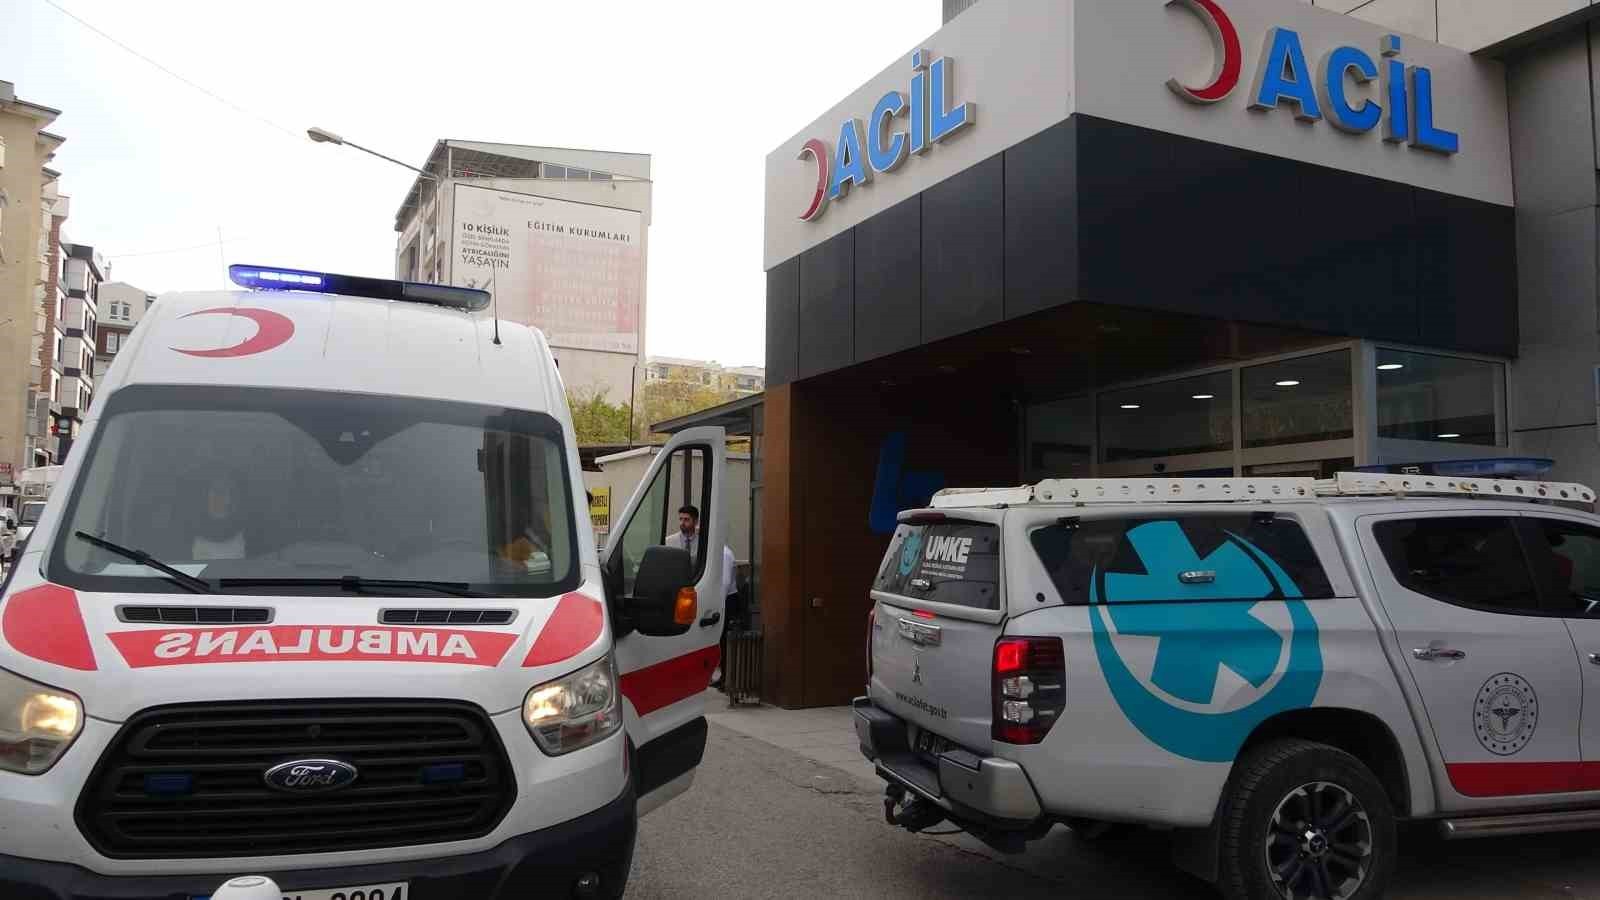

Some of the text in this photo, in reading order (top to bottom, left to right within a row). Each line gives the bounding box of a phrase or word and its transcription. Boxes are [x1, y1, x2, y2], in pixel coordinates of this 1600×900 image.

[1248, 25, 1459, 154] ACİL
[829, 49, 976, 201] ACİL
[463, 223, 509, 237] 10 KİŞİLİK
[569, 226, 630, 242] KURUMLARI
[462, 254, 509, 269] YAŞAYIN
[926, 535, 972, 564] UMKE
[285, 765, 337, 786] Ford
